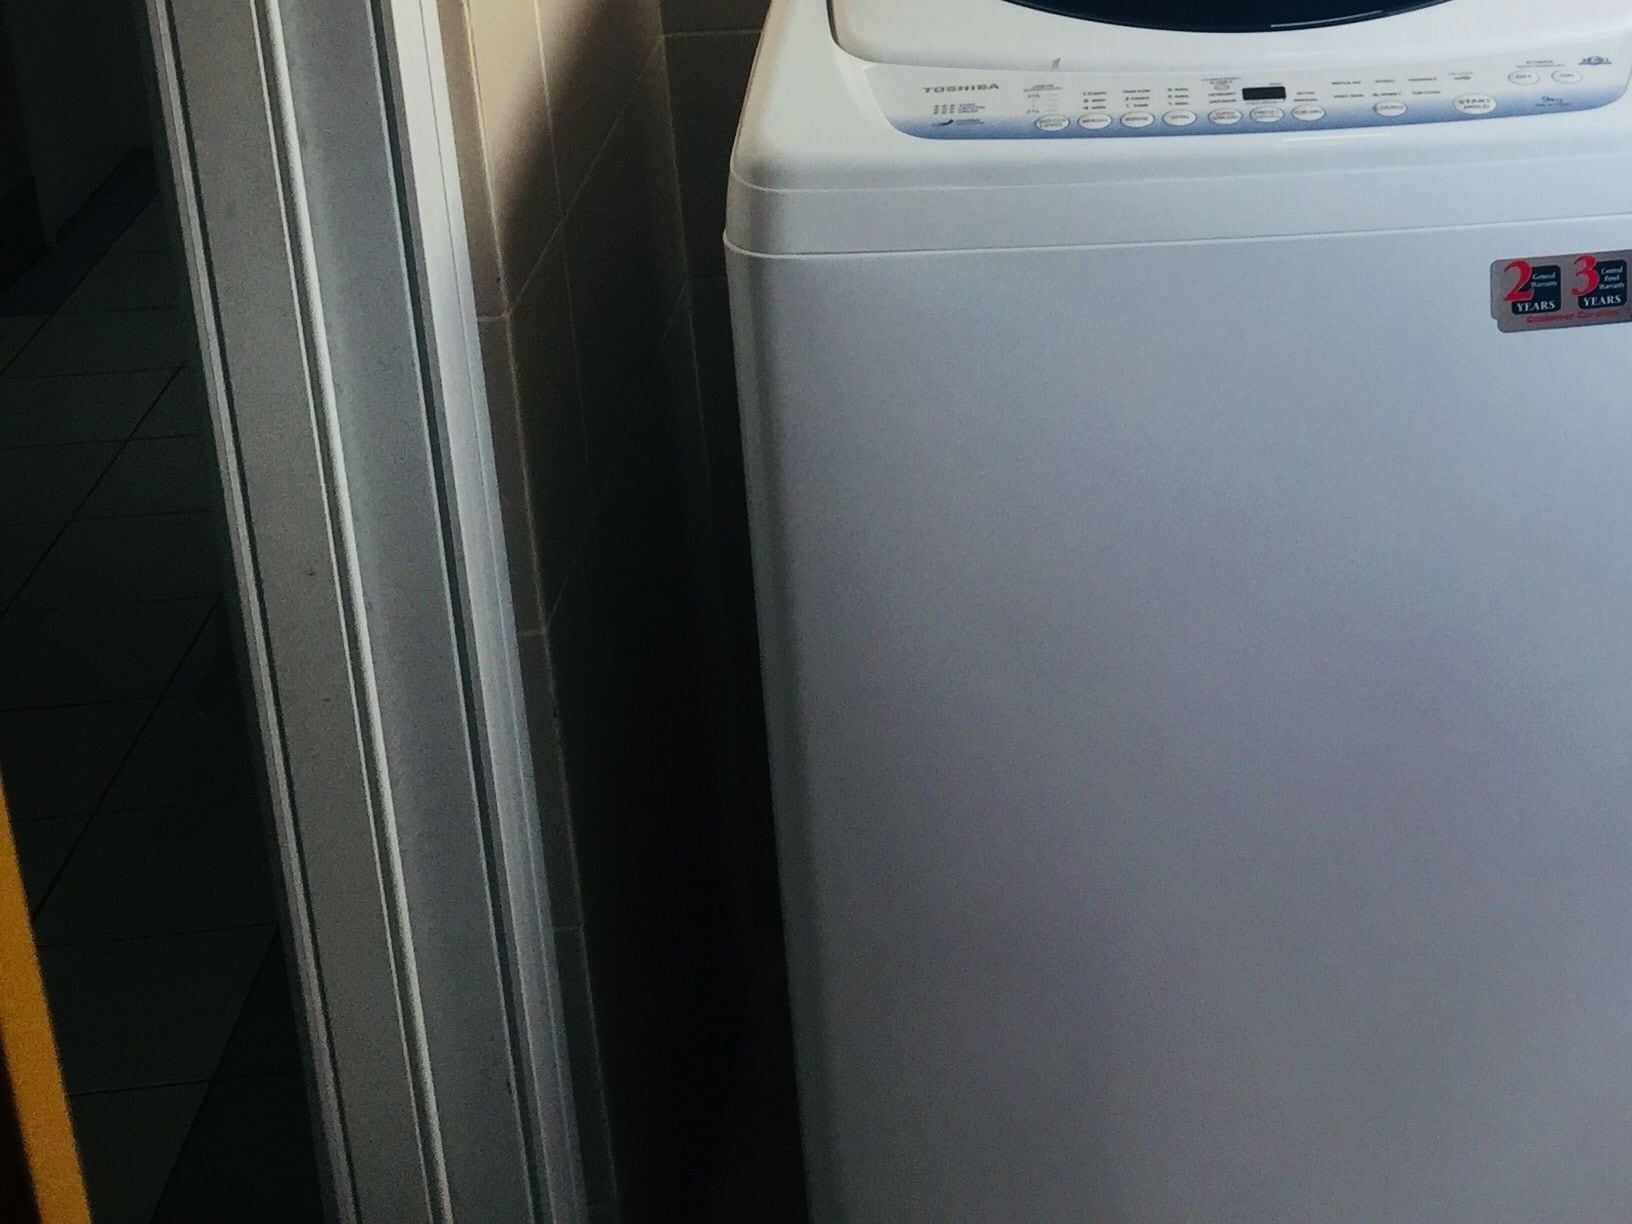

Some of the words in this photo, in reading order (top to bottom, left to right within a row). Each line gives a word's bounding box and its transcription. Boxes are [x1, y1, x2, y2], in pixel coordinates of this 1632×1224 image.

[922, 83, 1000, 93] TOSHIBA
[1504, 259, 1534, 302] 2
[1571, 255, 1600, 296] 3
[1531, 279, 1558, 288] Warranty
[1598, 281, 1626, 291] Warranty
[1516, 300, 1556, 313] YEARS
[1583, 294, 1622, 307] YEARS
